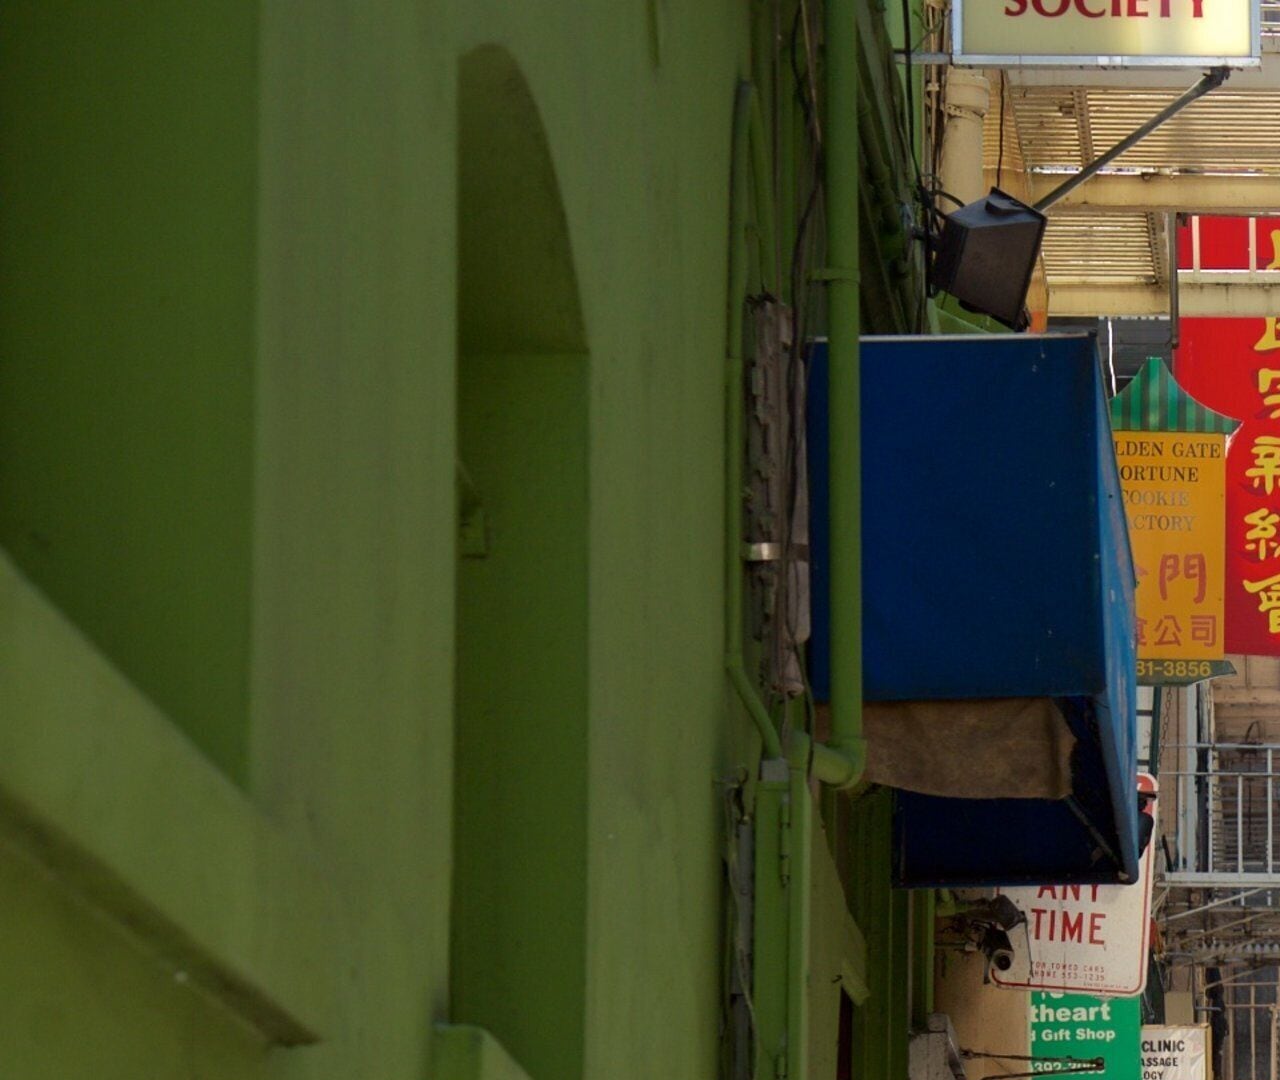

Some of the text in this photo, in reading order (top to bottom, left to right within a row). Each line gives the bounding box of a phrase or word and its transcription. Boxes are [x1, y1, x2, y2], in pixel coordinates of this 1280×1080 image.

[1115, 440, 1221, 458] LDEN GATE
[1120, 465, 1199, 482] ORTUNE
[1031, 908, 1106, 946] TIME
[1041, 1028, 1071, 1041] Gift
[1076, 1027, 1116, 1042] Shop
[1141, 1040, 1185, 1053] CLINIC
